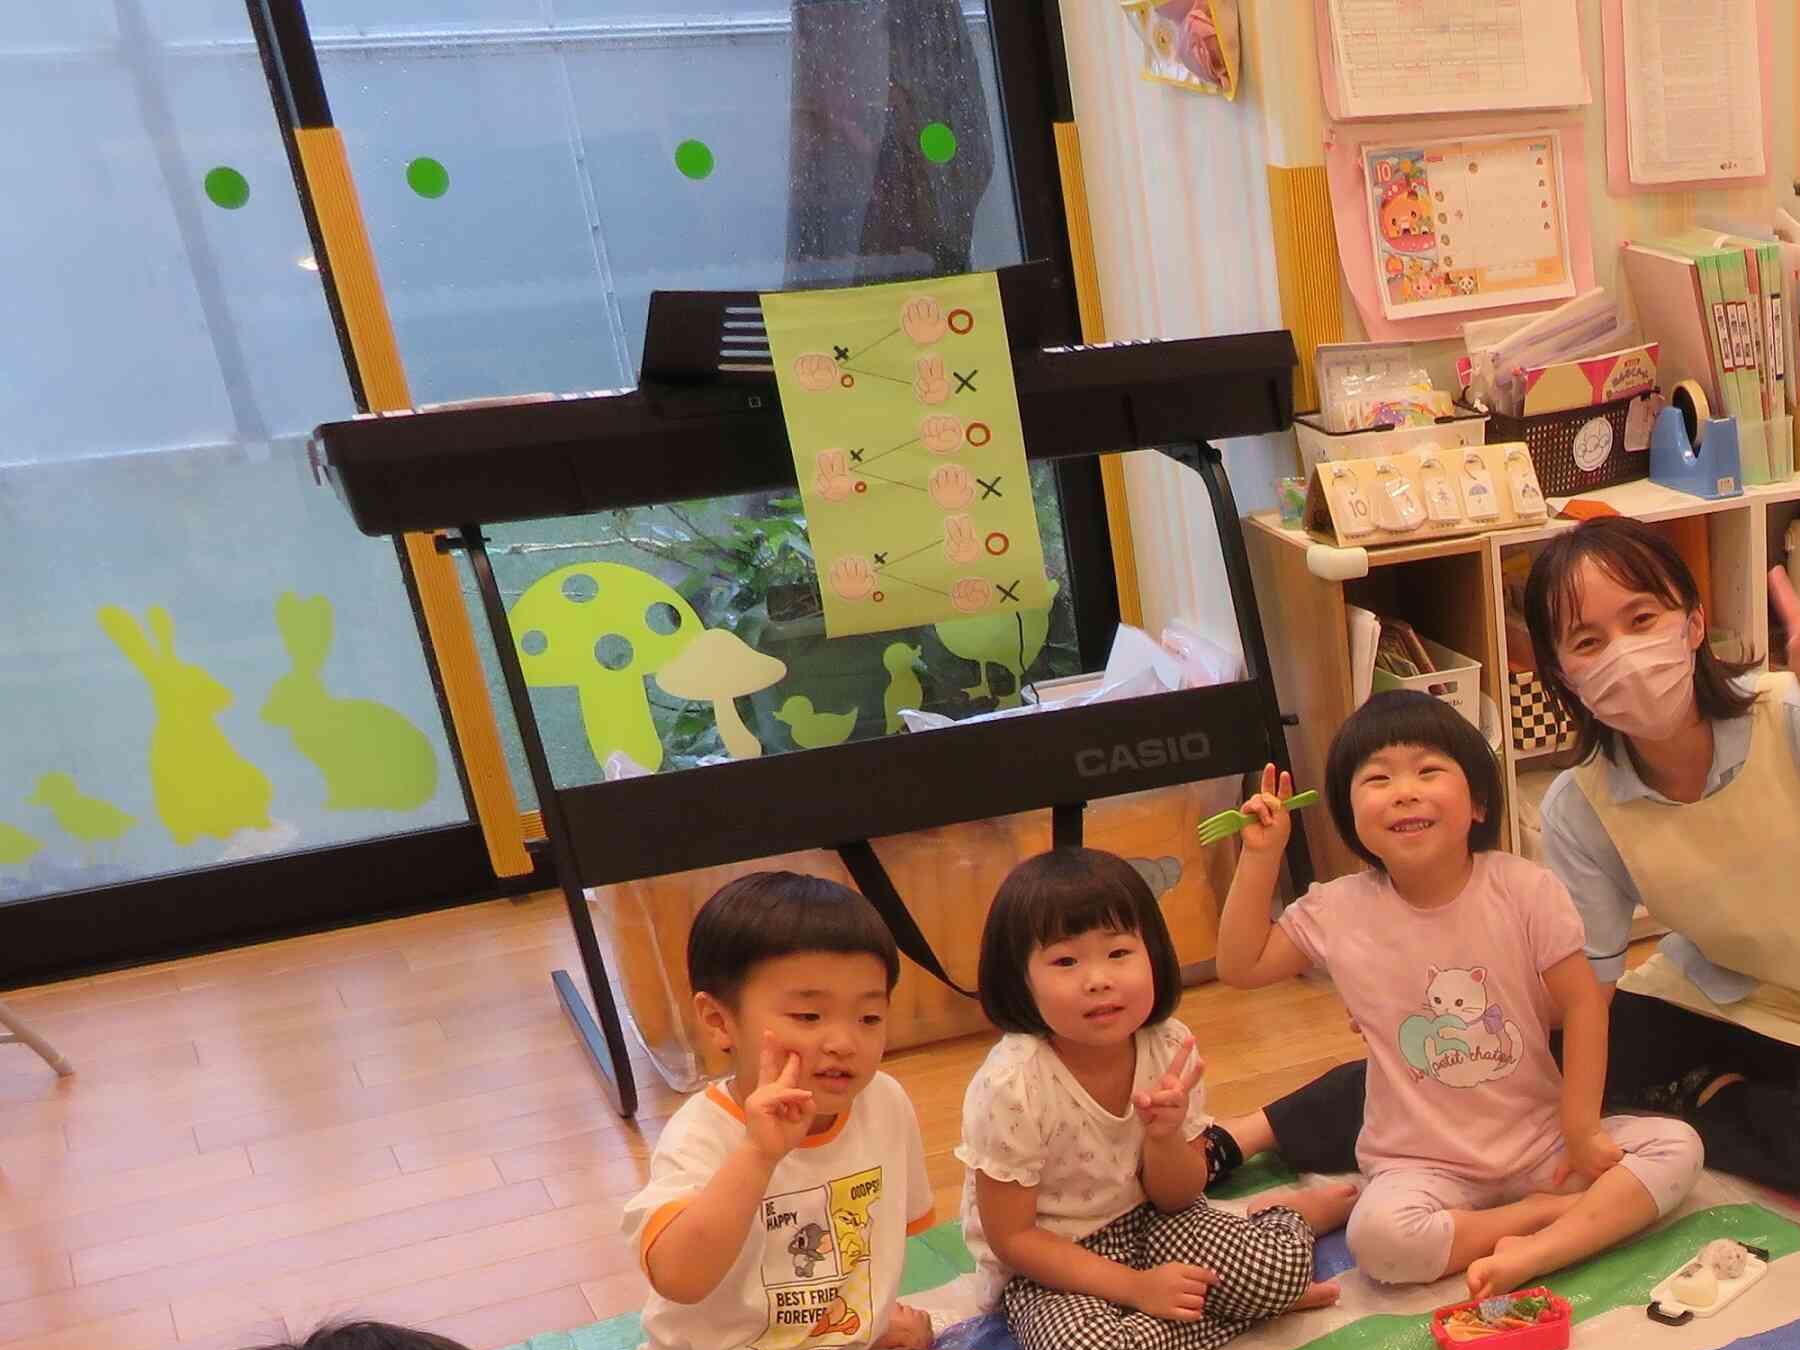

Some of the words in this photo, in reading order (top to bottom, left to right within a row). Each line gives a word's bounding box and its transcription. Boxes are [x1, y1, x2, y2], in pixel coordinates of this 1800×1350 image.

[1346, 498, 1369, 519] 10
[1074, 733, 1212, 777] CASIO
[765, 1200, 776, 1216] BE
[766, 1211, 798, 1232] HAPPY
[776, 1290, 806, 1307] BEST
[776, 1306, 828, 1325] FOREVE
